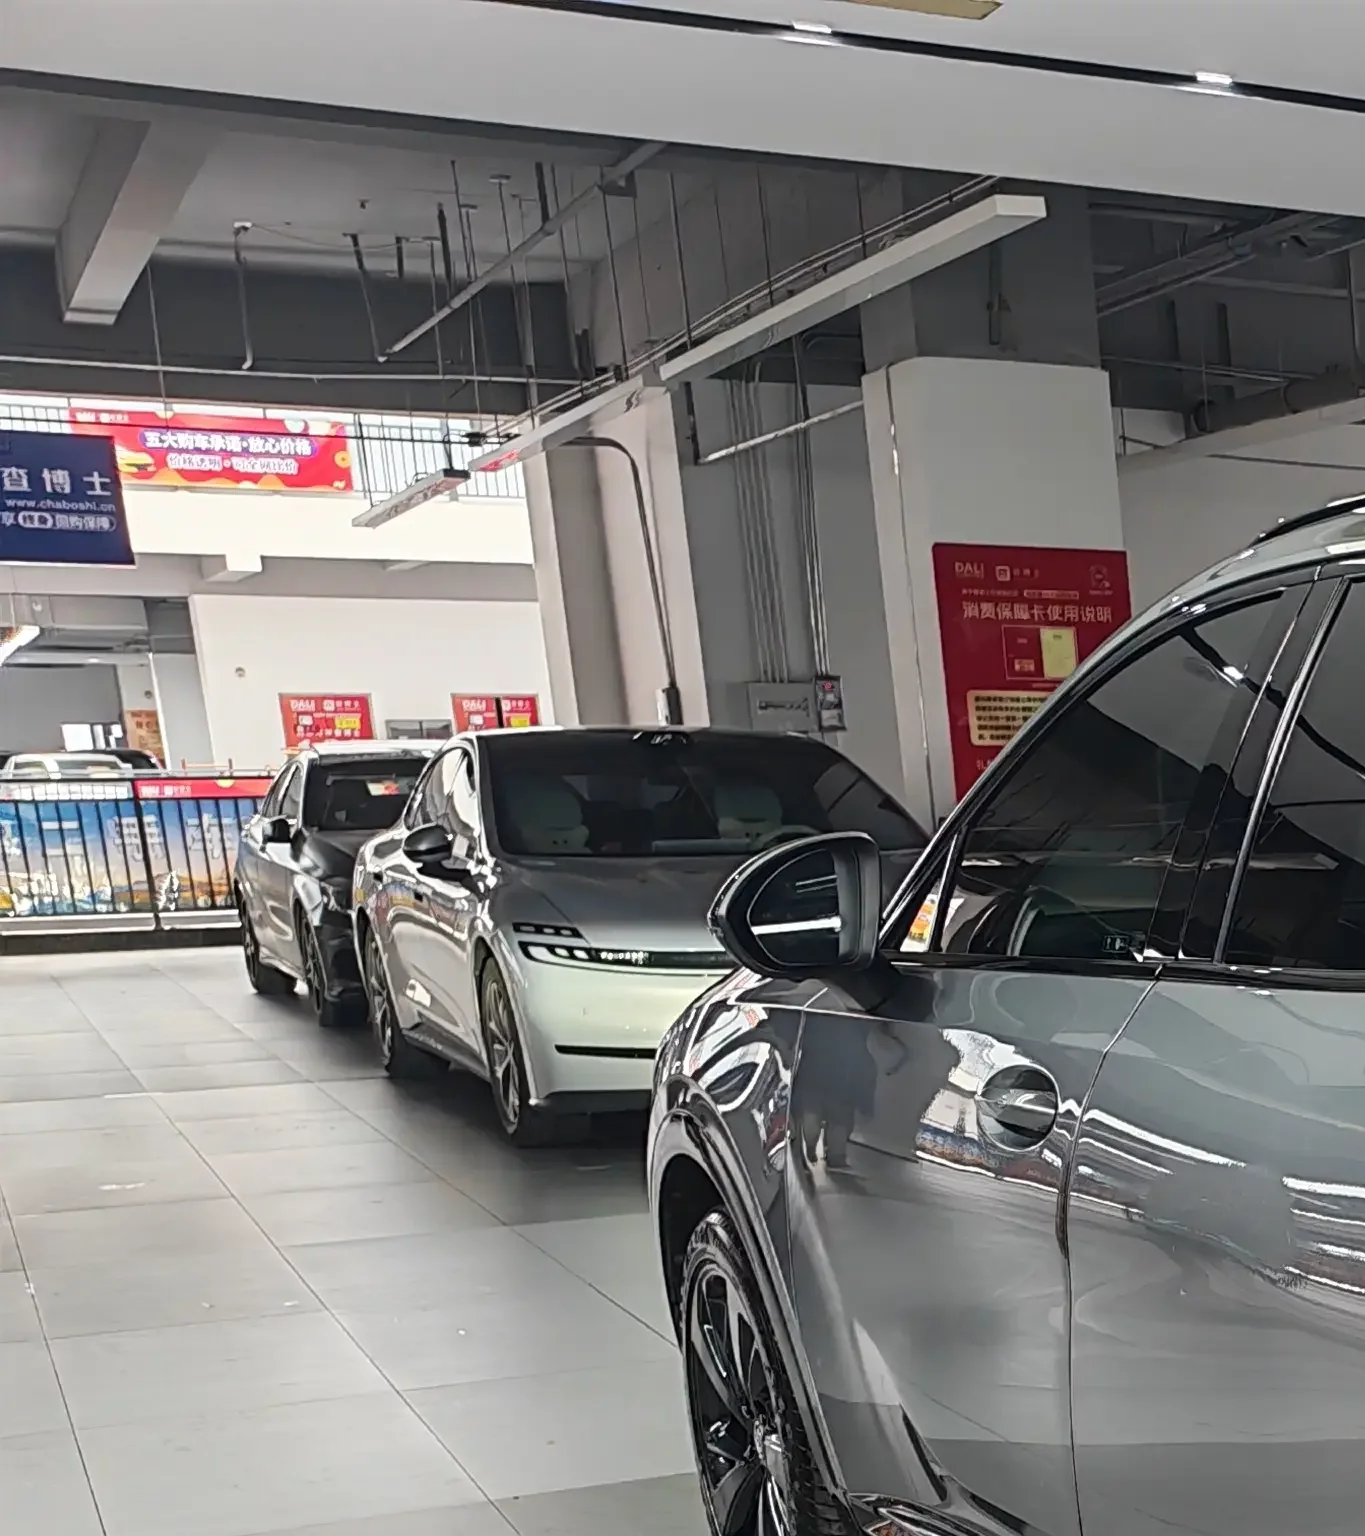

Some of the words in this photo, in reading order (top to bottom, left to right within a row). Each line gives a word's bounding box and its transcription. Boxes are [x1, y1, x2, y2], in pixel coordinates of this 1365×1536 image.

[1, 466, 113, 497] 查博士
[4, 498, 117, 512] www.chaboshi.cn
[954, 561, 985, 578] DALI
[963, 600, 1113, 624] 消费保障卡使用说明
